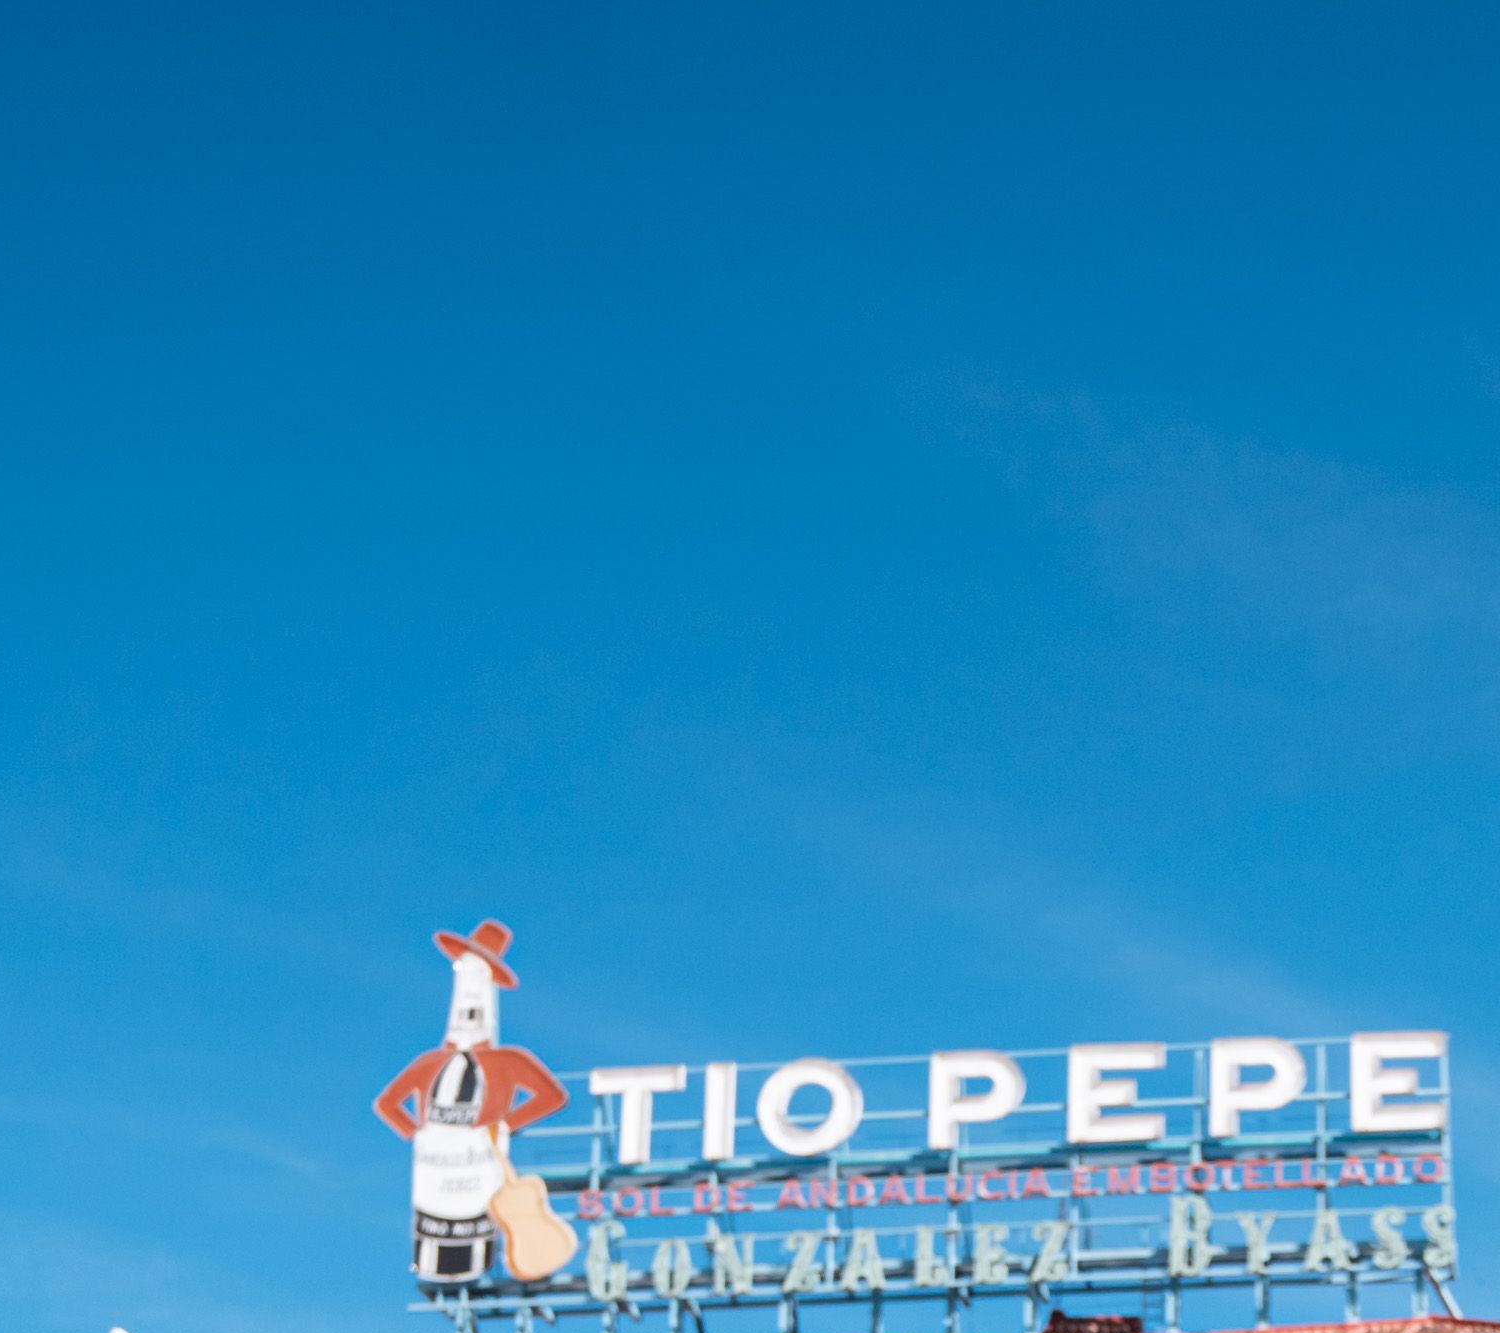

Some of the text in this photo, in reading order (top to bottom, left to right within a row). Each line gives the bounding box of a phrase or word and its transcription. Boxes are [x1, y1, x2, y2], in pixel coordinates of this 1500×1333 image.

[589, 1031, 1449, 1165] TIO PEPE
[577, 1153, 1446, 1219] SOL DE ANDALUCIA EMBOTELLADO
[586, 1197, 1457, 1301] GONZALEZ BYASS
